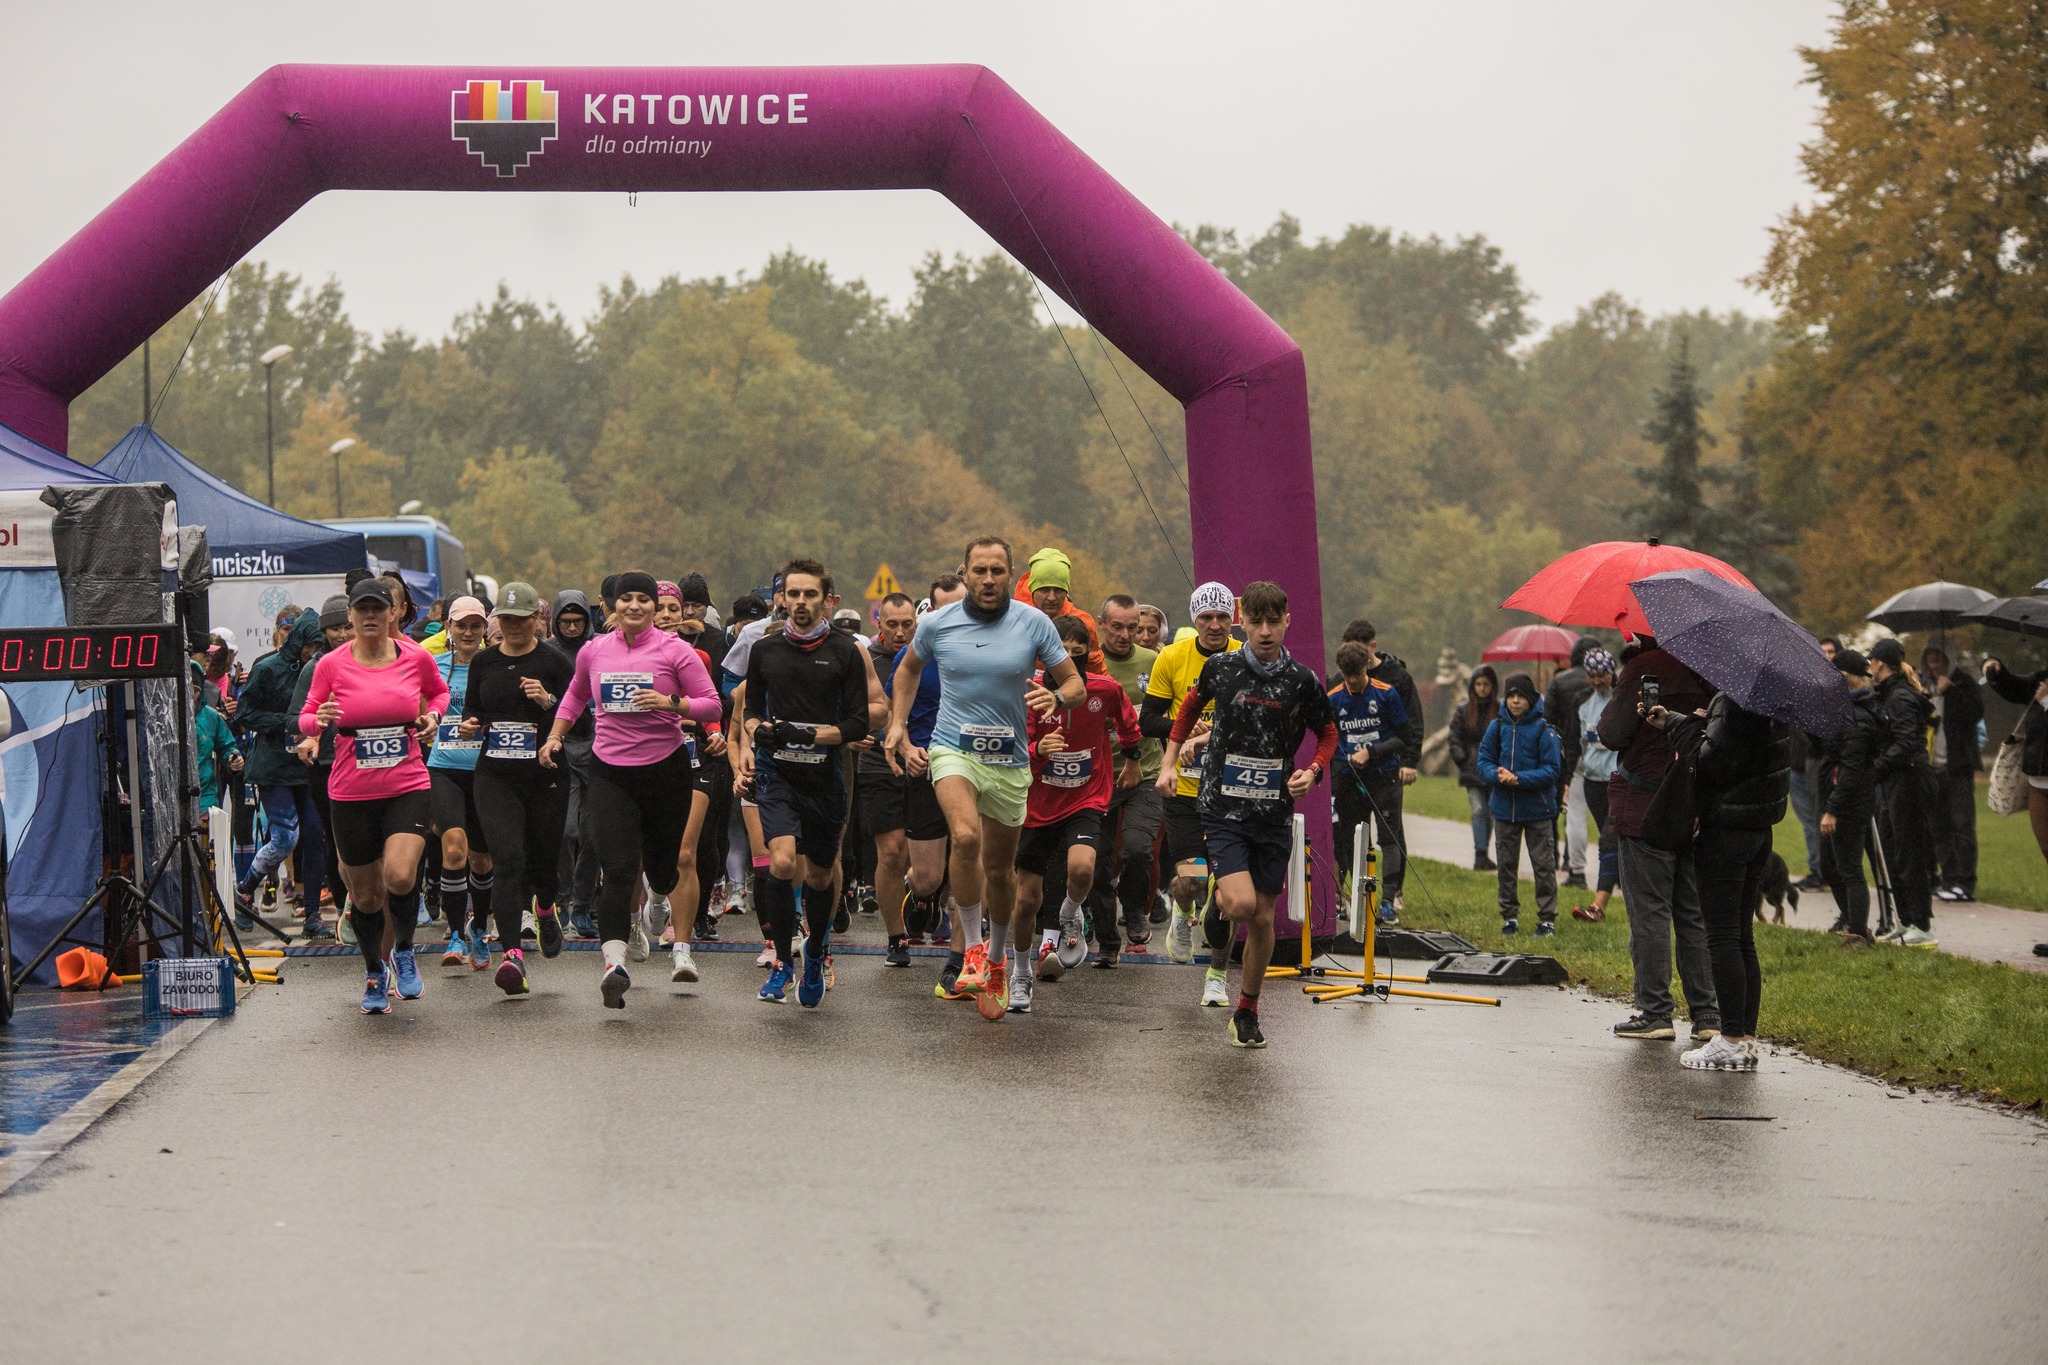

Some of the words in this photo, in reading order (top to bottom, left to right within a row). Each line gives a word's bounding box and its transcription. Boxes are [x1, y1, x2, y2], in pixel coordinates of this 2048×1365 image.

[584, 93, 809, 125] KATOWICE
[585, 134, 616, 154] dla
[622, 134, 712, 158] odmiany
[212, 549, 285, 576] nciszka
[611, 684, 640, 699] 52
[1339, 717, 1381, 731] Emirates
[362, 738, 402, 755] 103
[498, 732, 525, 747] 32
[972, 737, 1003, 751] 60
[1053, 762, 1081, 776] 59
[1236, 769, 1269, 786] 45
[175, 971, 213, 981] BIURO
